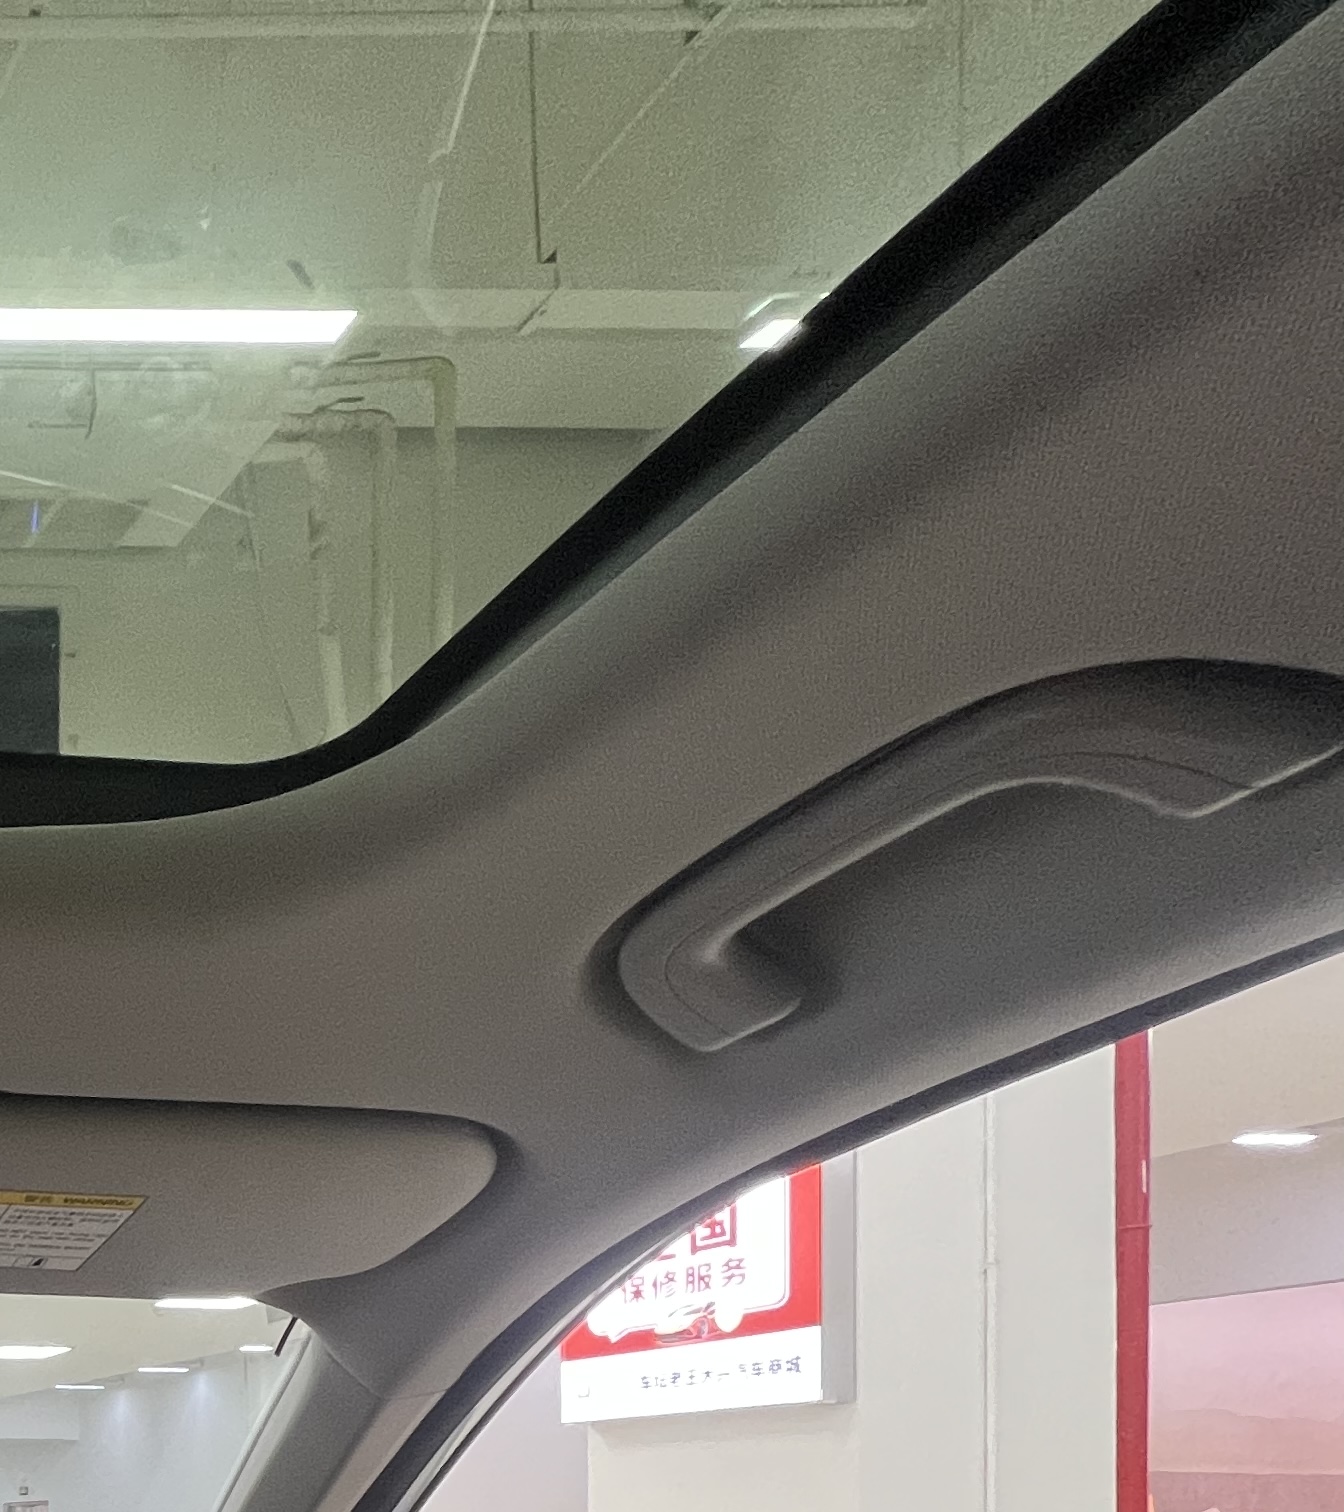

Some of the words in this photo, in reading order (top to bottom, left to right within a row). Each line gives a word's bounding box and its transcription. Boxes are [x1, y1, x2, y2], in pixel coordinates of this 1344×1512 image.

[657, 1203, 737, 1261] 国
[622, 1257, 746, 1304] 保修服务
